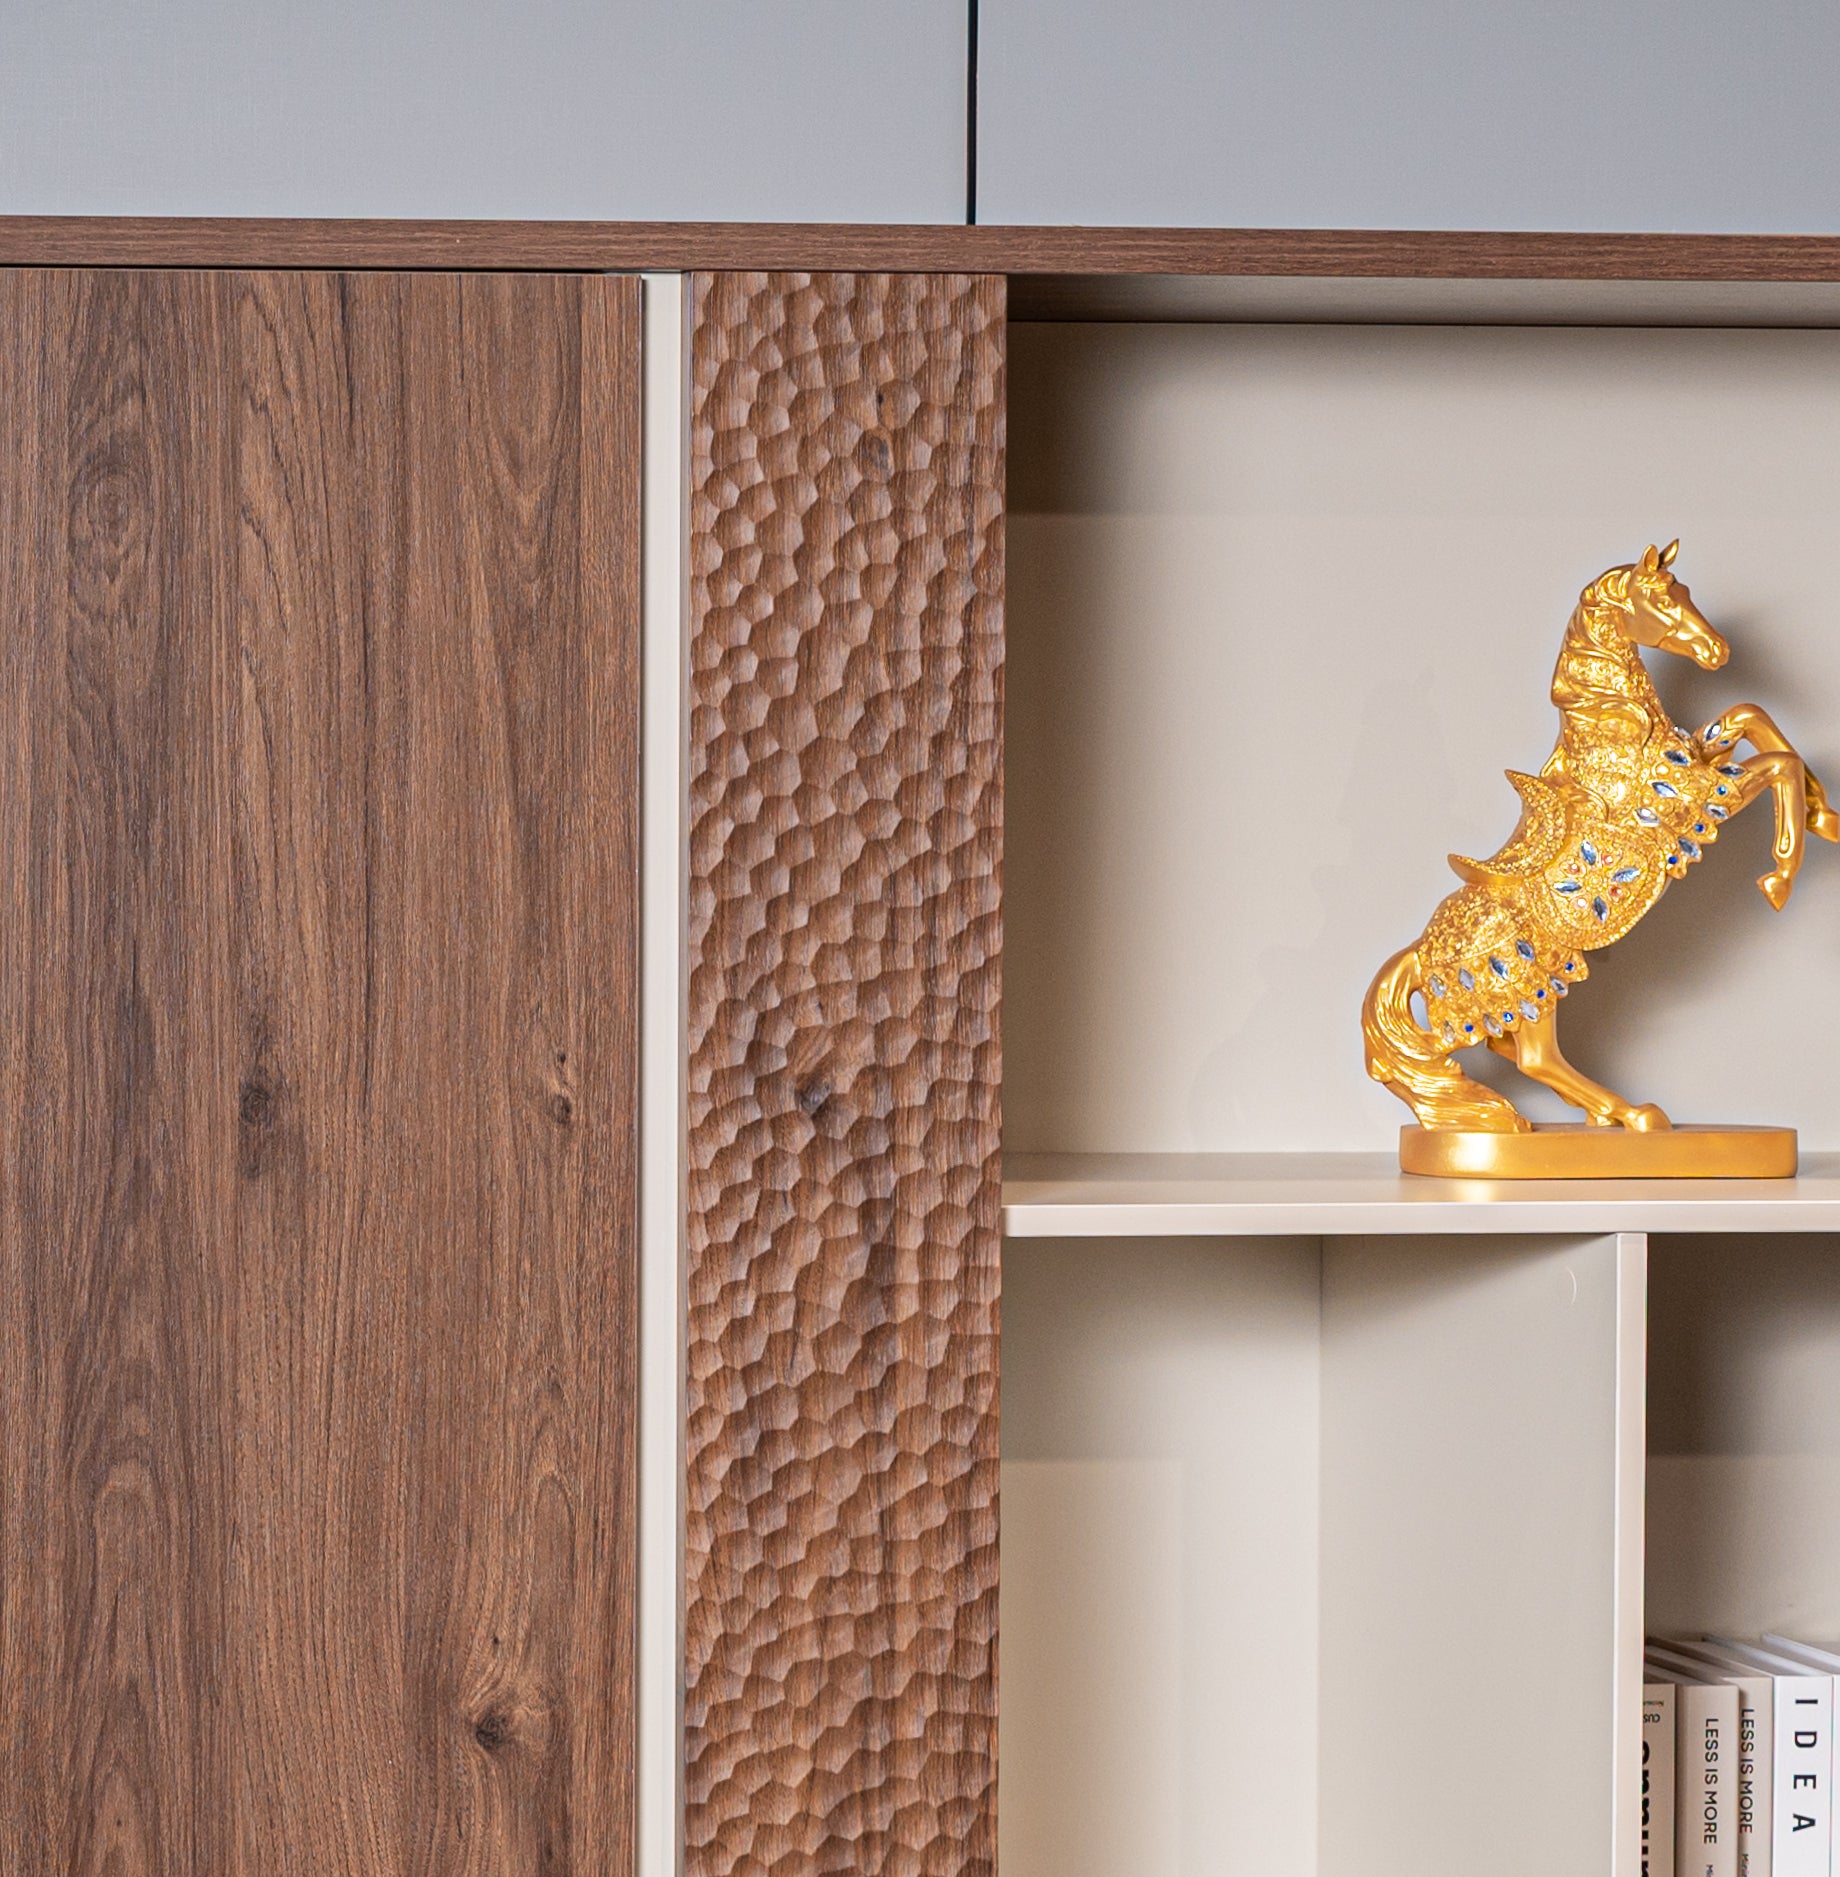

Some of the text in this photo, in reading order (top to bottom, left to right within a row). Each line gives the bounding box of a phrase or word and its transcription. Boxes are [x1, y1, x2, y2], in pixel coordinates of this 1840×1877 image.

[1703, 1718, 1719, 1844] LESS IS MORE
[1739, 1708, 1755, 1834] LESS IS MORE
[1792, 1698, 1819, 1833] IDEA
